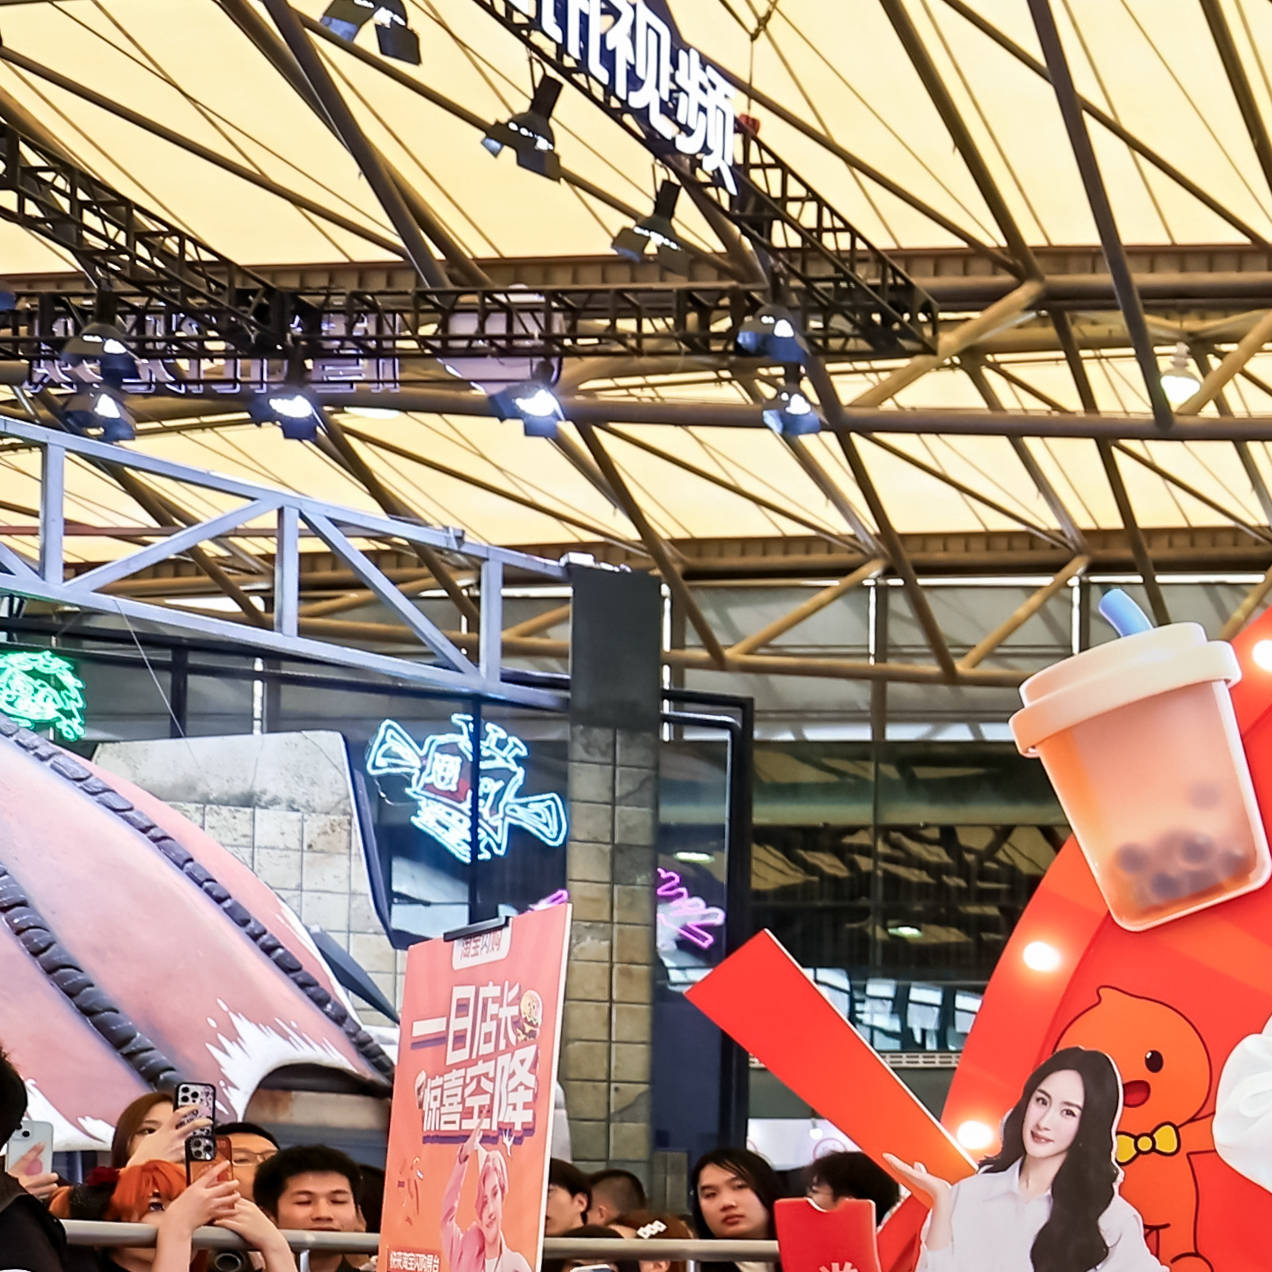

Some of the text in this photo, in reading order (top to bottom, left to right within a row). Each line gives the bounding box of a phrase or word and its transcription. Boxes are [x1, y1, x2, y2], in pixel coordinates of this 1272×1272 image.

[412, 980, 520, 1066] 一日店长
[421, 1044, 537, 1132] 惊喜空降
